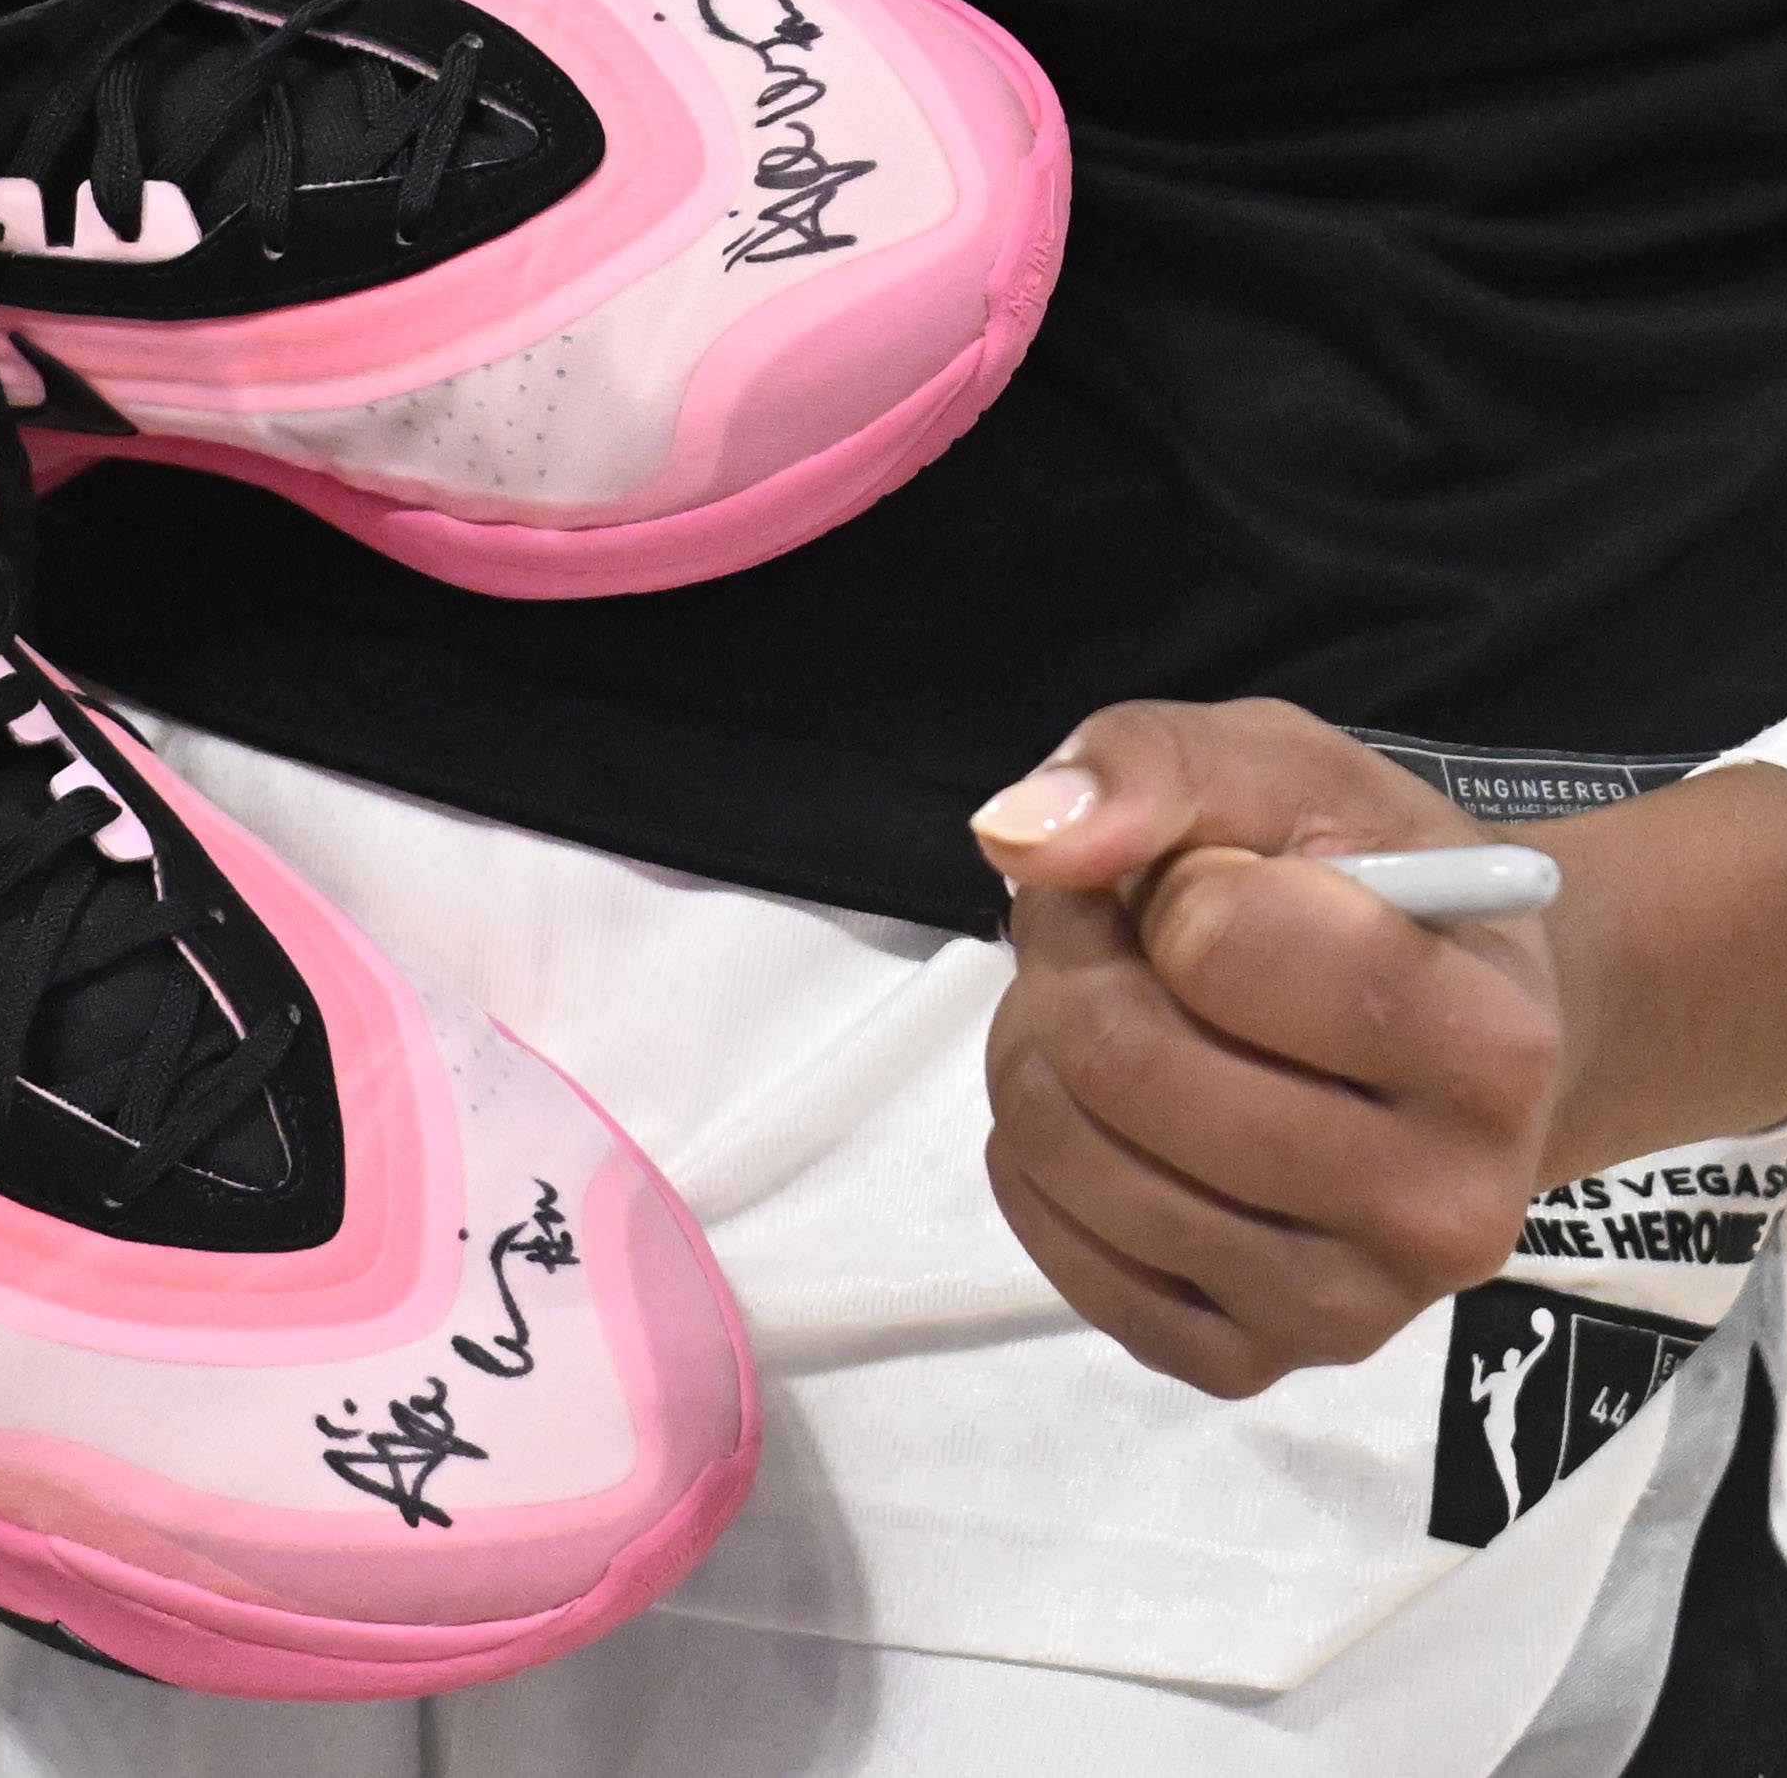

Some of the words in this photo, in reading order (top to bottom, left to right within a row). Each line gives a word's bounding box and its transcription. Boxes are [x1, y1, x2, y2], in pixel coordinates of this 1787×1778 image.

[1457, 776, 1626, 800] ENGINEERED
[1480, 803, 1503, 815] THE
[1530, 1177, 1611, 1210] AS
